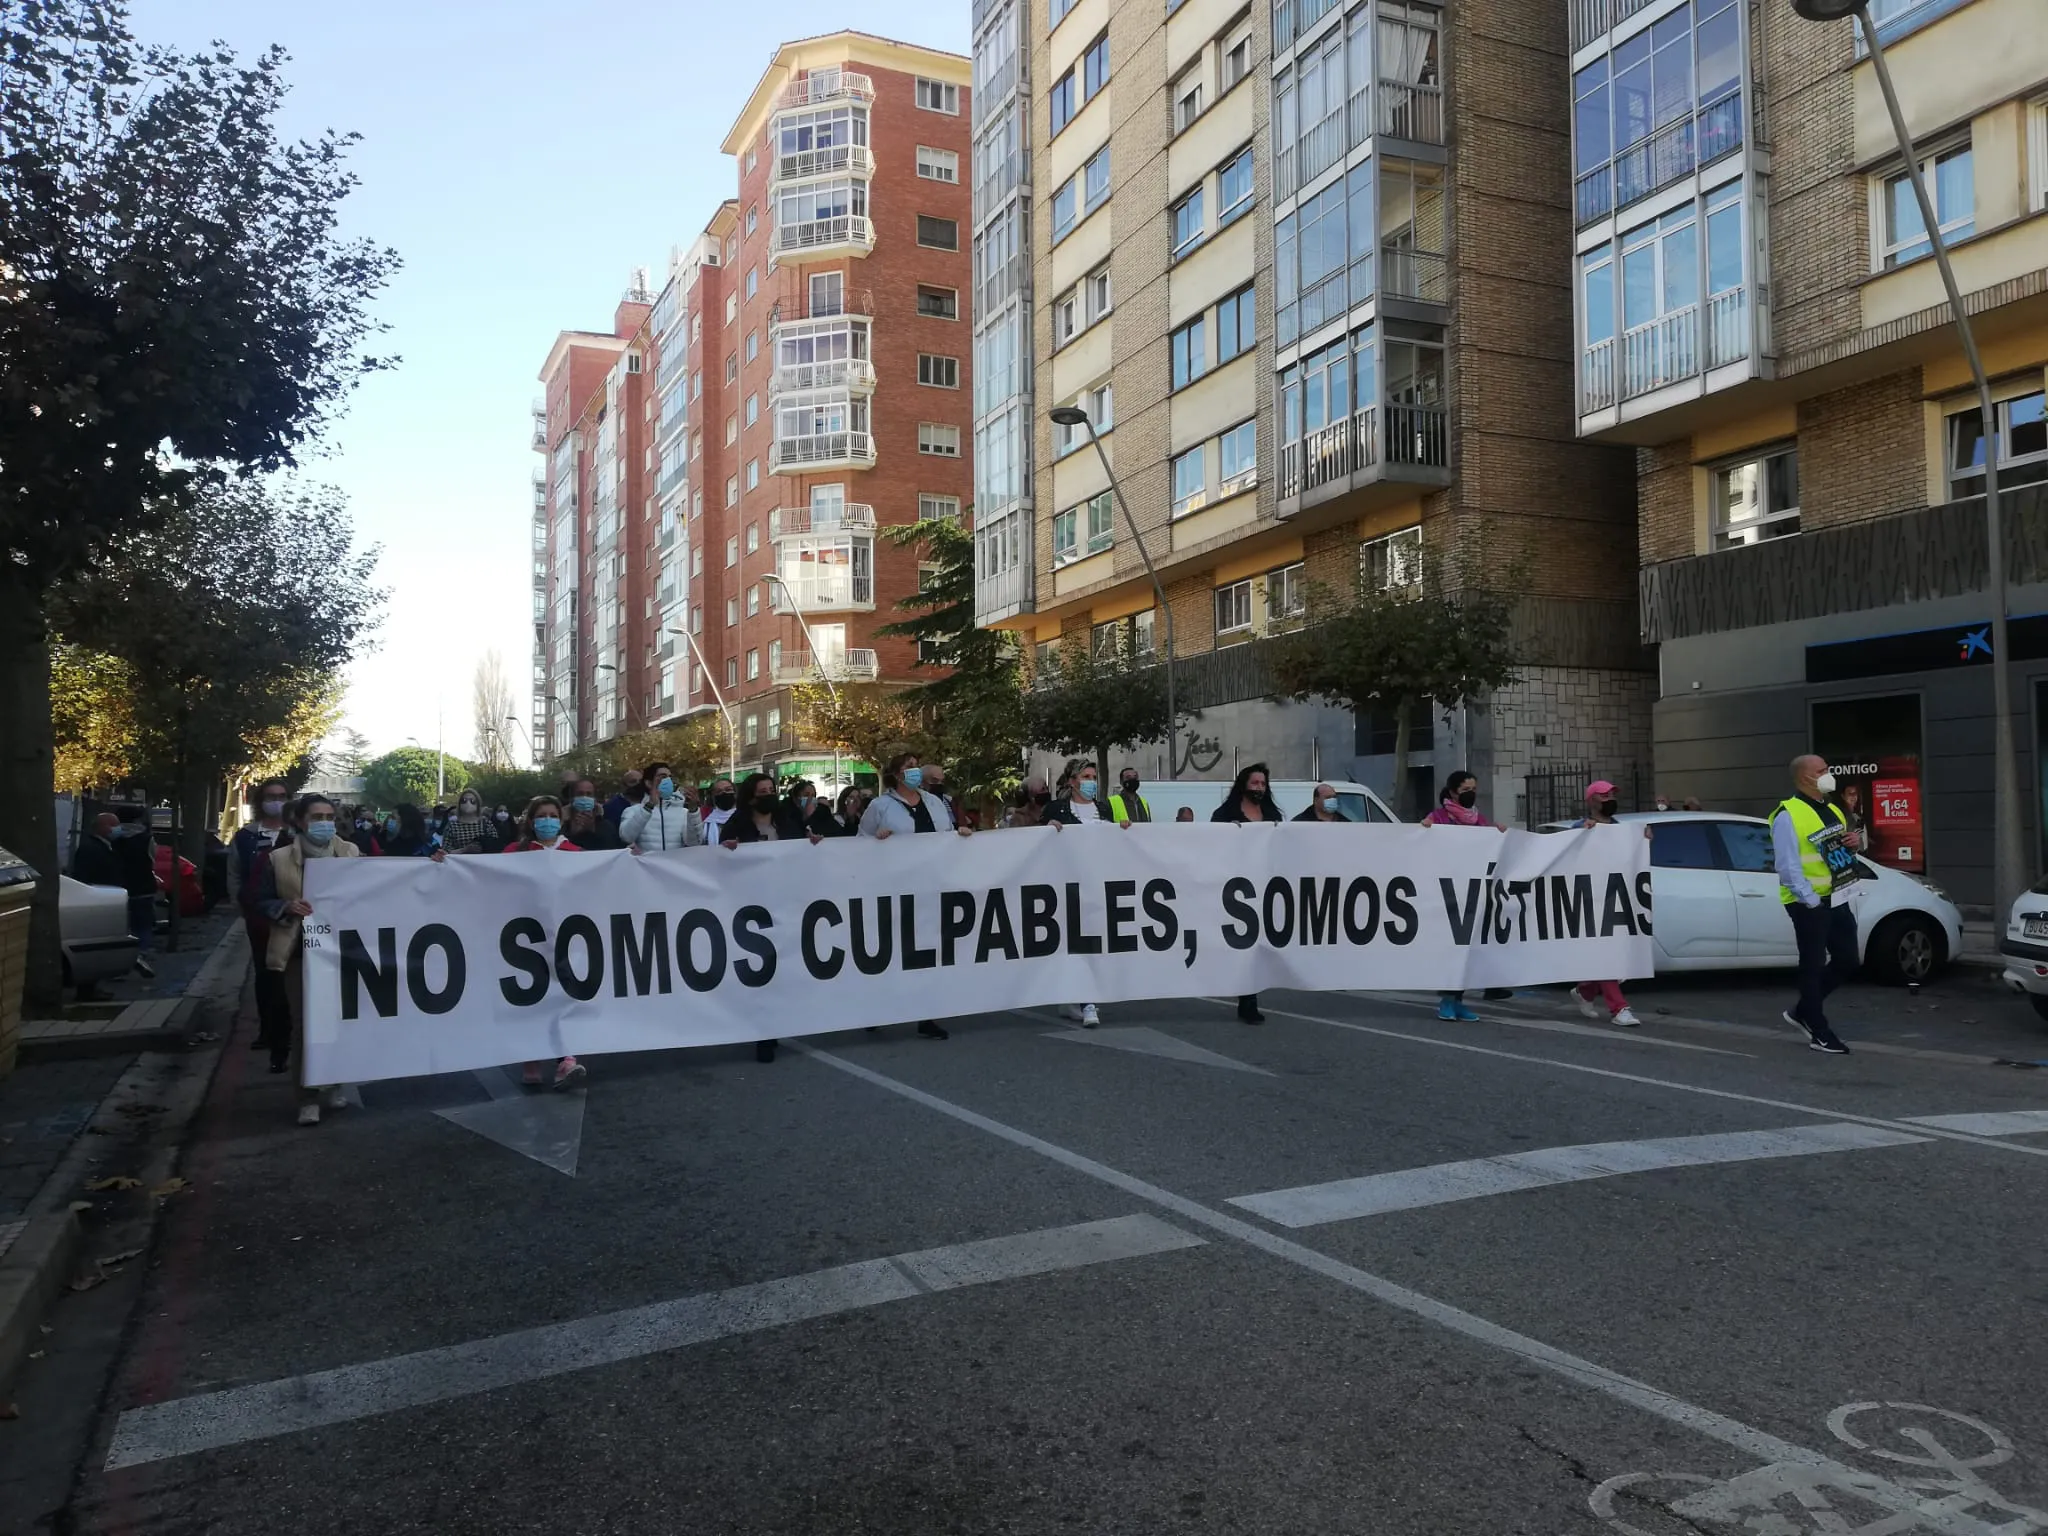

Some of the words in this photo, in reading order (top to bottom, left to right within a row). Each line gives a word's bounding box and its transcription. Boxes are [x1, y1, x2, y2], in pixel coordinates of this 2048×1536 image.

[1828, 763, 1878, 776] CONTIGO
[339, 923, 466, 1020] NO
[498, 905, 777, 1006] SOMOS
[801, 880, 1197, 981] CULPABLES,
[1221, 875, 1419, 949] SOMOS
[1439, 861, 1653, 946] VÍCTIMAS
